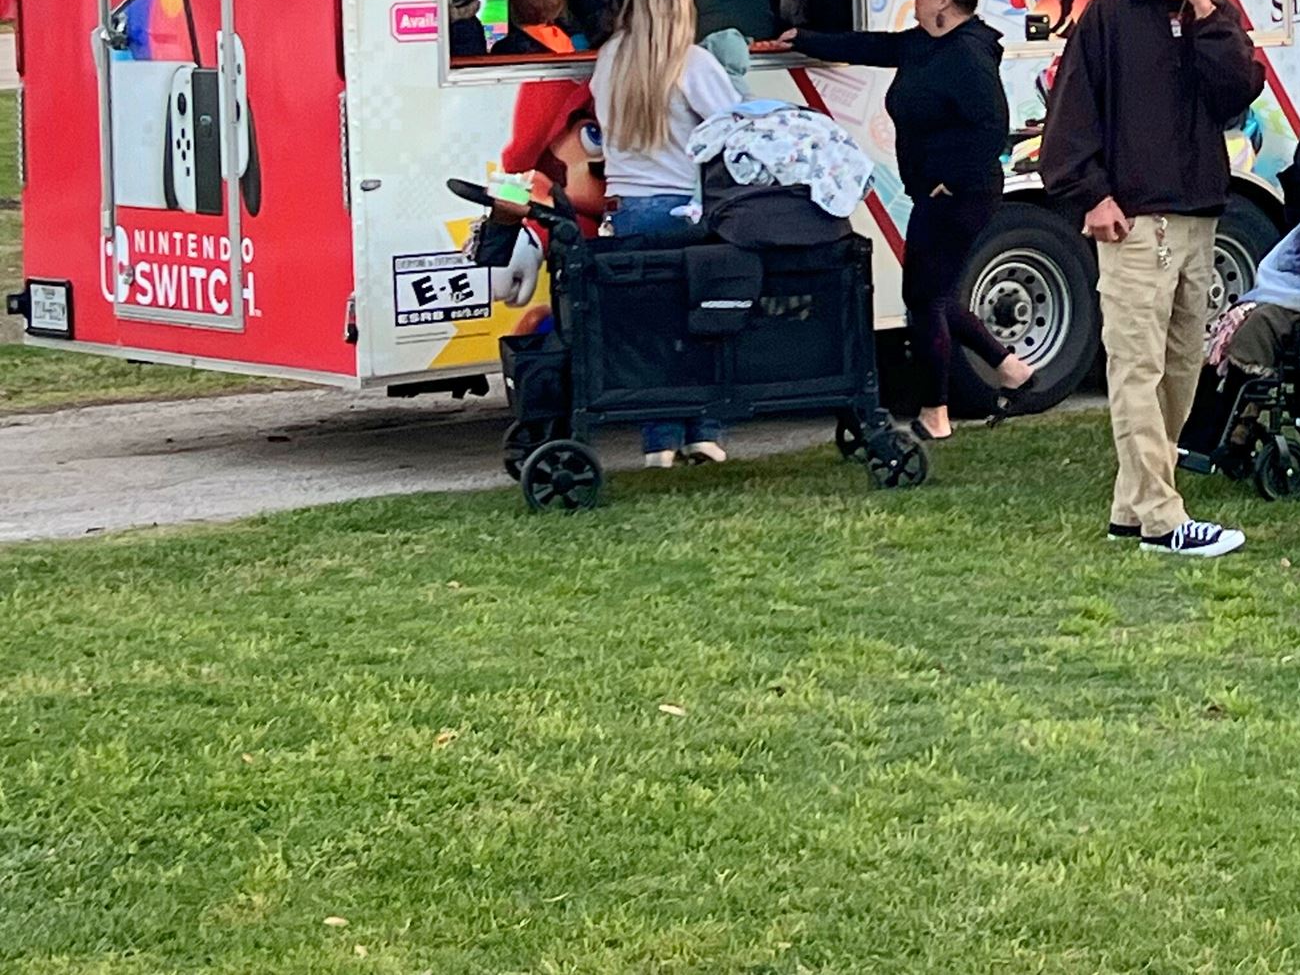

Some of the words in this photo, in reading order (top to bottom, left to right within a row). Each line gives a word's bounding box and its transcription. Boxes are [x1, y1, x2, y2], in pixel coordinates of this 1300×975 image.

[400, 12, 437, 28] Avail
[134, 229, 254, 264] NINTENDO
[134, 260, 256, 317] SWITCH
[397, 310, 445, 325] ESRB
